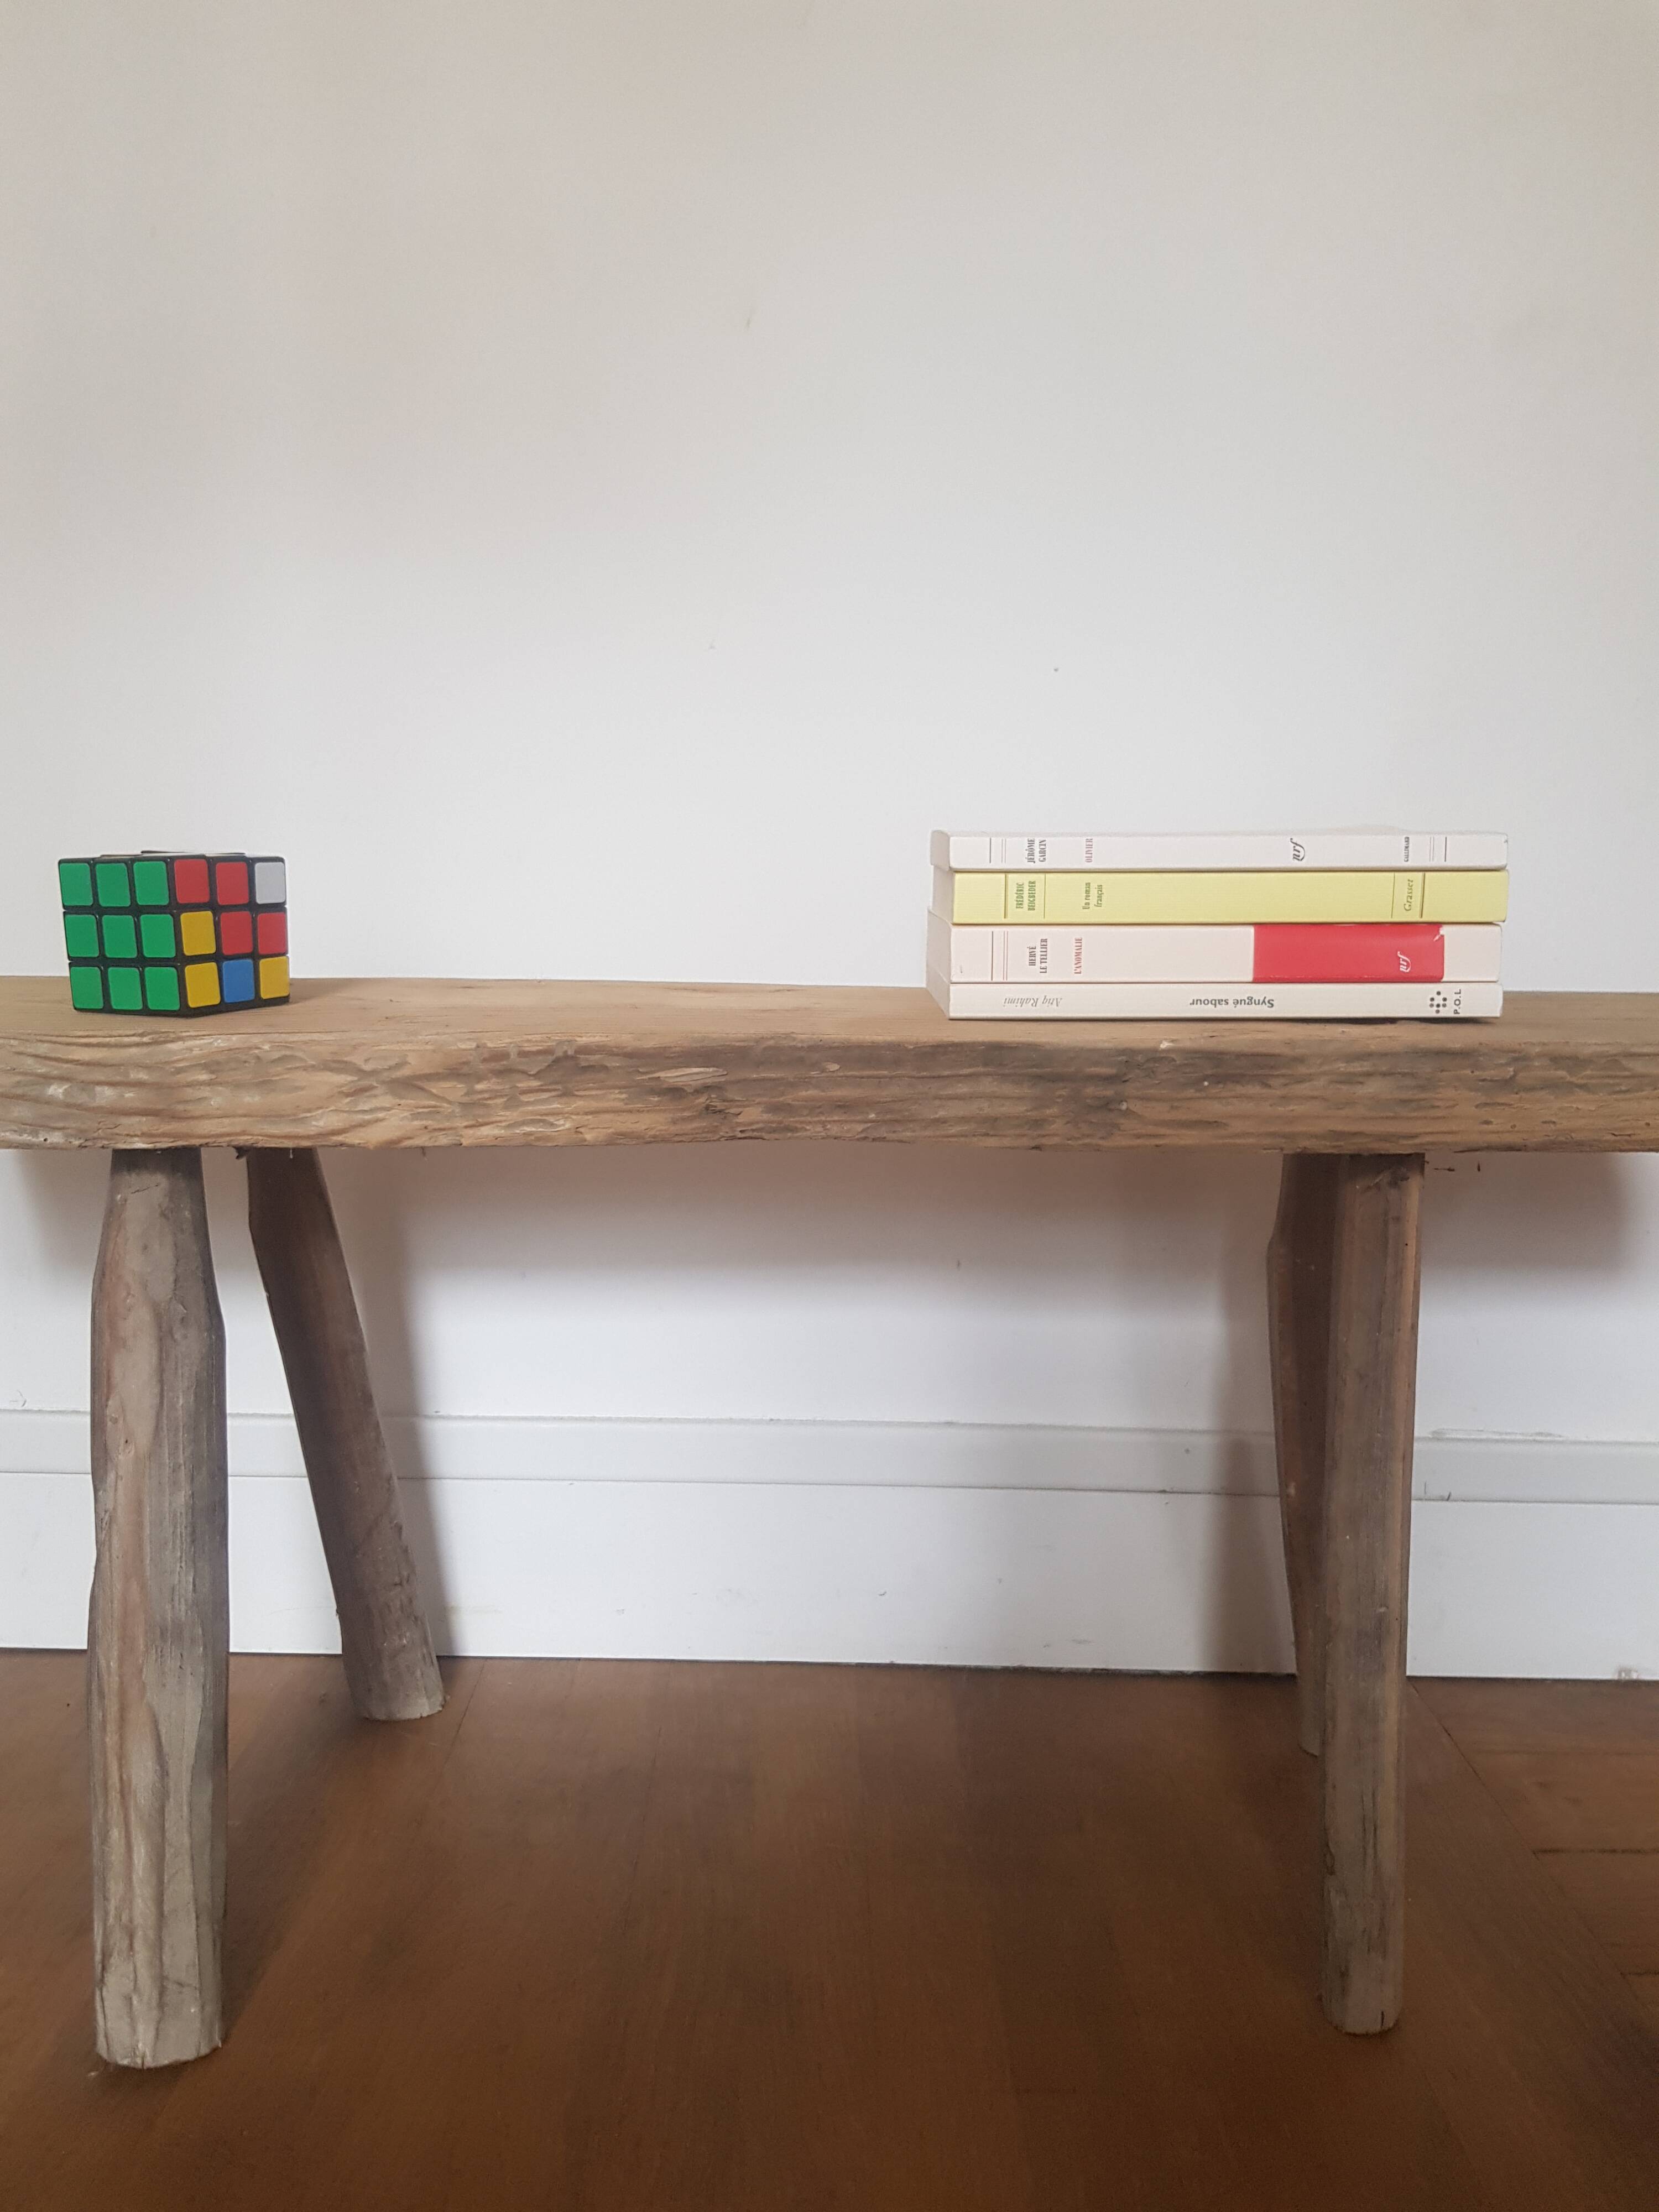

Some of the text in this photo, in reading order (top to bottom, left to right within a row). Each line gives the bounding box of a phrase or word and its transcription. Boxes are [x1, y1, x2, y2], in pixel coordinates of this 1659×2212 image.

[1025, 838, 1035, 863] JÉRÔME
[1039, 839, 1047, 863] GARCIN
[1084, 837, 1093, 863] OLIVIER
[1015, 882, 1024, 909] FRÉDÉRIC
[1027, 880, 1036, 911] BEIGBEDER
[1082, 901, 1091, 910] Un
[1094, 884, 1104, 907] français
[1403, 879, 1413, 912] Grasset
[1027, 945, 1036, 966] HERVÉ
[1039, 938, 1048, 974] LE TELLIER
[1073, 937, 1082, 974] L'ANOMALIE
[1003, 995, 1063, 1008] Atiq Rahimi
[1190, 996, 1275, 1009] Syngué sabour
